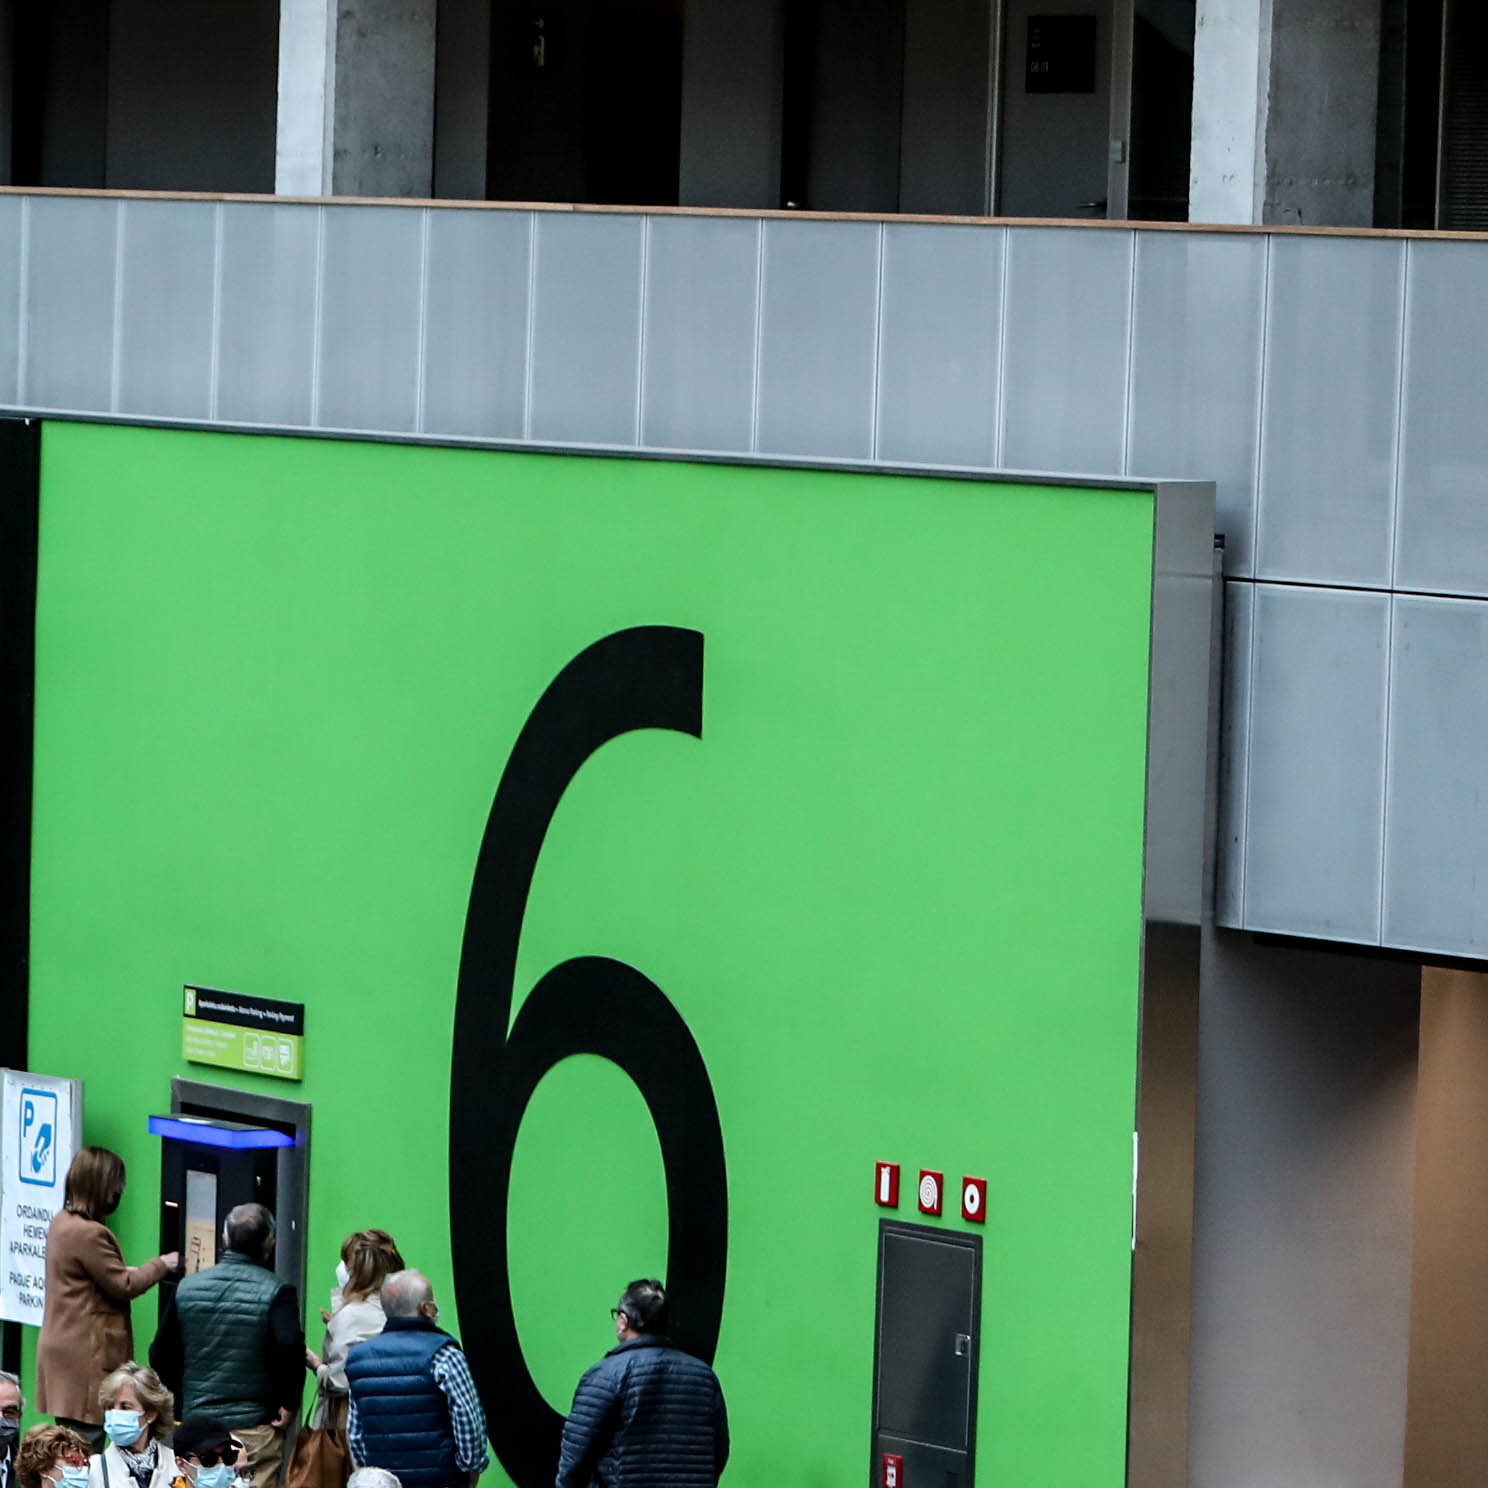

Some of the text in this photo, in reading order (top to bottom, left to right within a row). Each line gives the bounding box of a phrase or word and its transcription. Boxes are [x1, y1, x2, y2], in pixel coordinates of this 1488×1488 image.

[24, 1100, 34, 1138] P
[9, 1240, 46, 1260] APARKALE
[8, 1271, 46, 1291] PAGUE AQ
